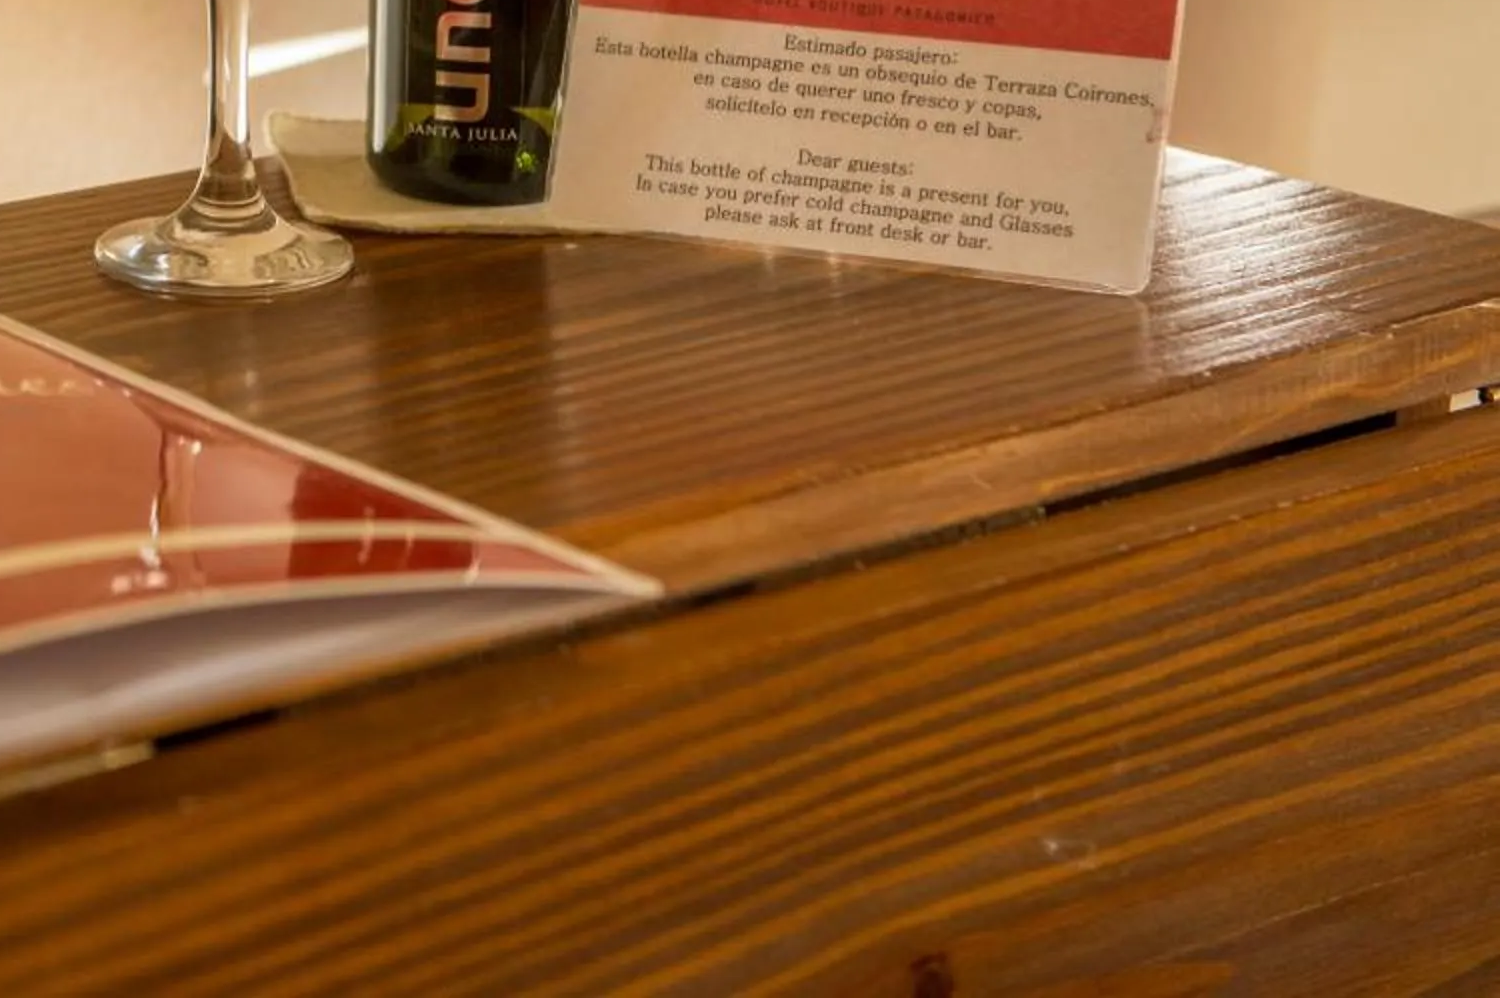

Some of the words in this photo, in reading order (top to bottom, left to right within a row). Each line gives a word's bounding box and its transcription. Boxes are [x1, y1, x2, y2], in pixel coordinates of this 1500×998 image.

[594, 36, 634, 56] Esta
[638, 42, 699, 63] botella
[704, 52, 805, 74] champagne
[811, 62, 831, 75] es
[838, 66, 859, 79] un
[865, 64, 948, 87] obsequio
[954, 73, 978, 90] de
[984, 74, 1058, 98] Terraza
[784, 33, 867, 59] Estimado
[873, 45, 959, 67] pasajero:
[693, 72, 715, 85] en
[720, 75, 762, 91] caso
[767, 77, 790, 93] de
[795, 82, 858, 101] querer
[862, 89, 896, 104] uno
[900, 89, 960, 111] fresco
[964, 99, 975, 114] y
[981, 100, 1043, 121] copas,
[408, 121, 462, 140] SANTA
[467, 127, 518, 142] JULIA
[793, 106, 815, 120] en
[820, 108, 910, 131] recepción
[915, 120, 928, 132] o
[933, 121, 957, 135] en
[962, 119, 980, 137] el
[986, 120, 1024, 142] bar.
[645, 153, 685, 174] This
[690, 159, 741, 180] bottle
[747, 166, 766, 183] of
[771, 169, 873, 195] champagne
[879, 178, 895, 196] is
[901, 186, 912, 199] a
[918, 185, 989, 208] present
[996, 191, 1025, 210] for
[798, 147, 843, 169] Dear
[846, 157, 915, 177] guests:
[635, 173, 653, 192] In
[658, 179, 699, 197] case
[704, 185, 738, 201] you
[743, 189, 800, 208] prefer
[804, 194, 844, 212] cold
[849, 199, 954, 225] champagne
[959, 211, 993, 229] and
[998, 213, 1074, 238] Glasses
[704, 204, 763, 225] please
[768, 211, 800, 230] ask
[806, 216, 823, 231] at
[829, 216, 874, 237] front
[880, 223, 924, 243] desk
[930, 231, 950, 246] or
[956, 230, 993, 251] bar.
